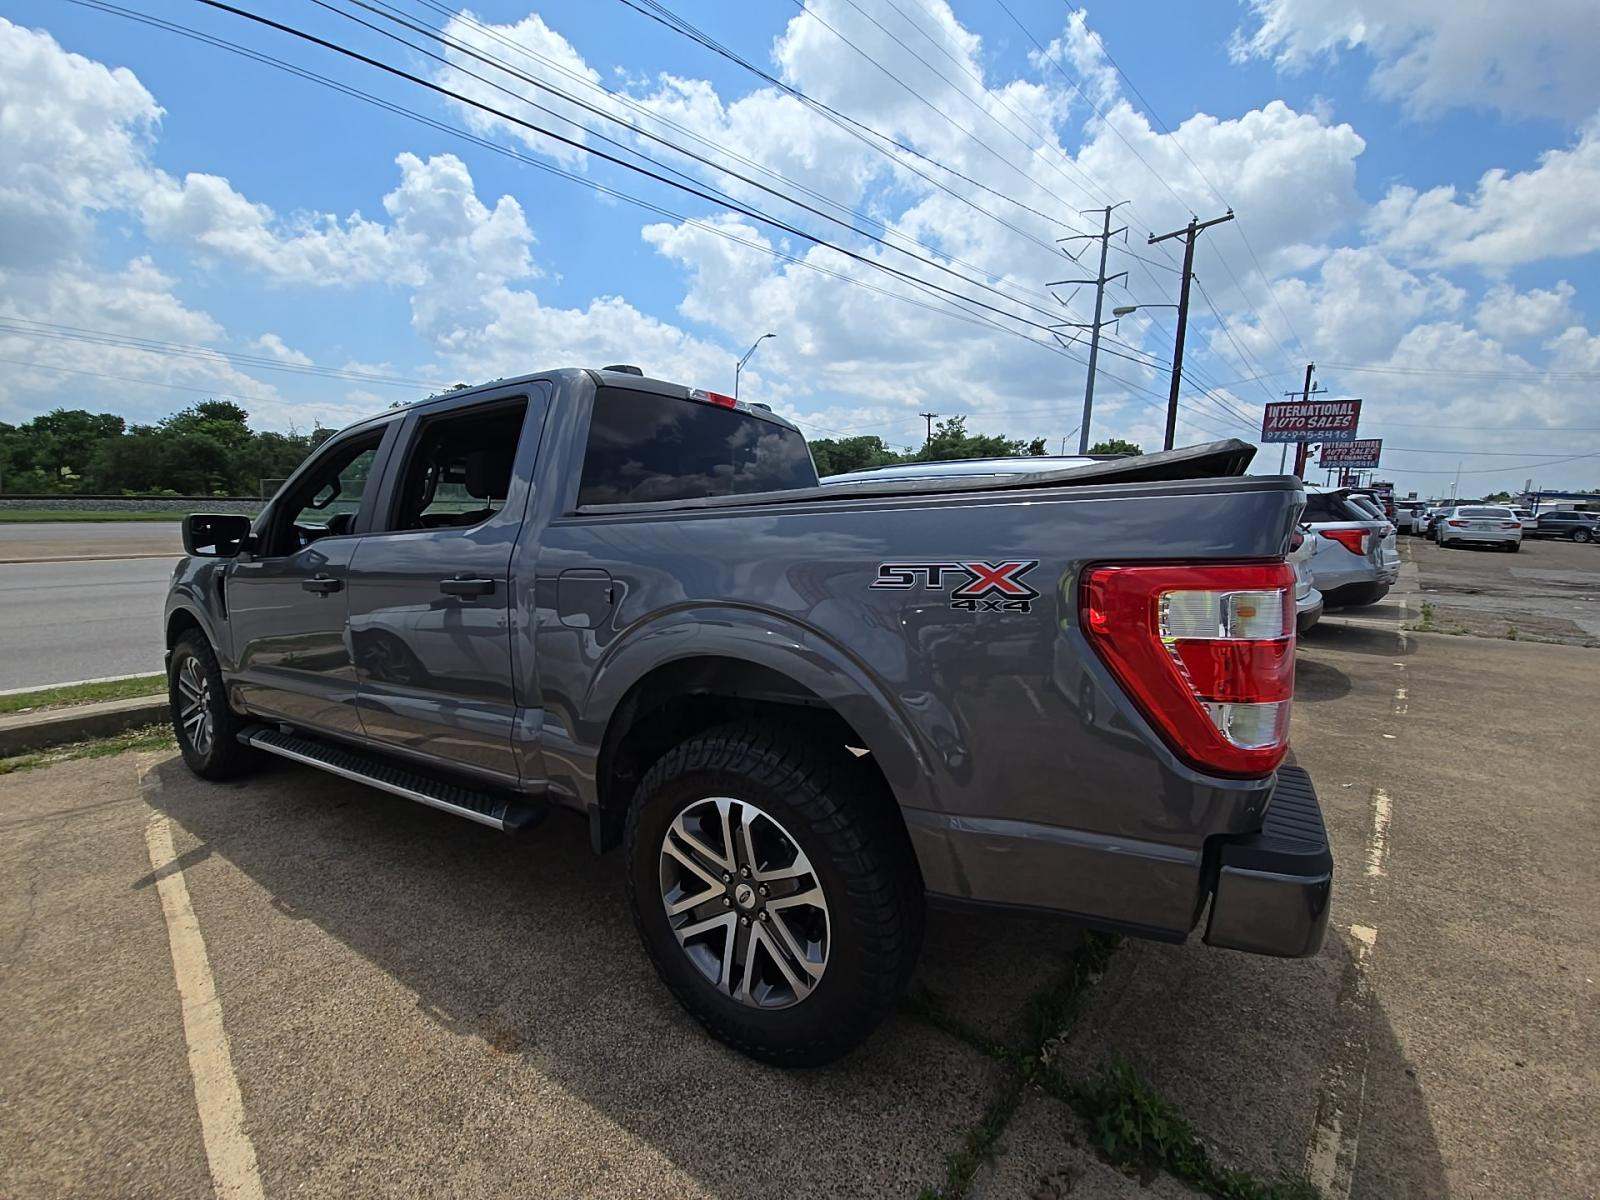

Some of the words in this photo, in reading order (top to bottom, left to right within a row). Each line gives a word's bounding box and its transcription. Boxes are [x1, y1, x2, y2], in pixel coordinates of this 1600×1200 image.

[1268, 403, 1355, 418] INTERNATIONAL
[1268, 417, 1306, 428] AUTO
[1307, 416, 1352, 428] SALES
[1323, 440, 1380, 449] INTERNATIONAL
[868, 559, 1041, 600] STX
